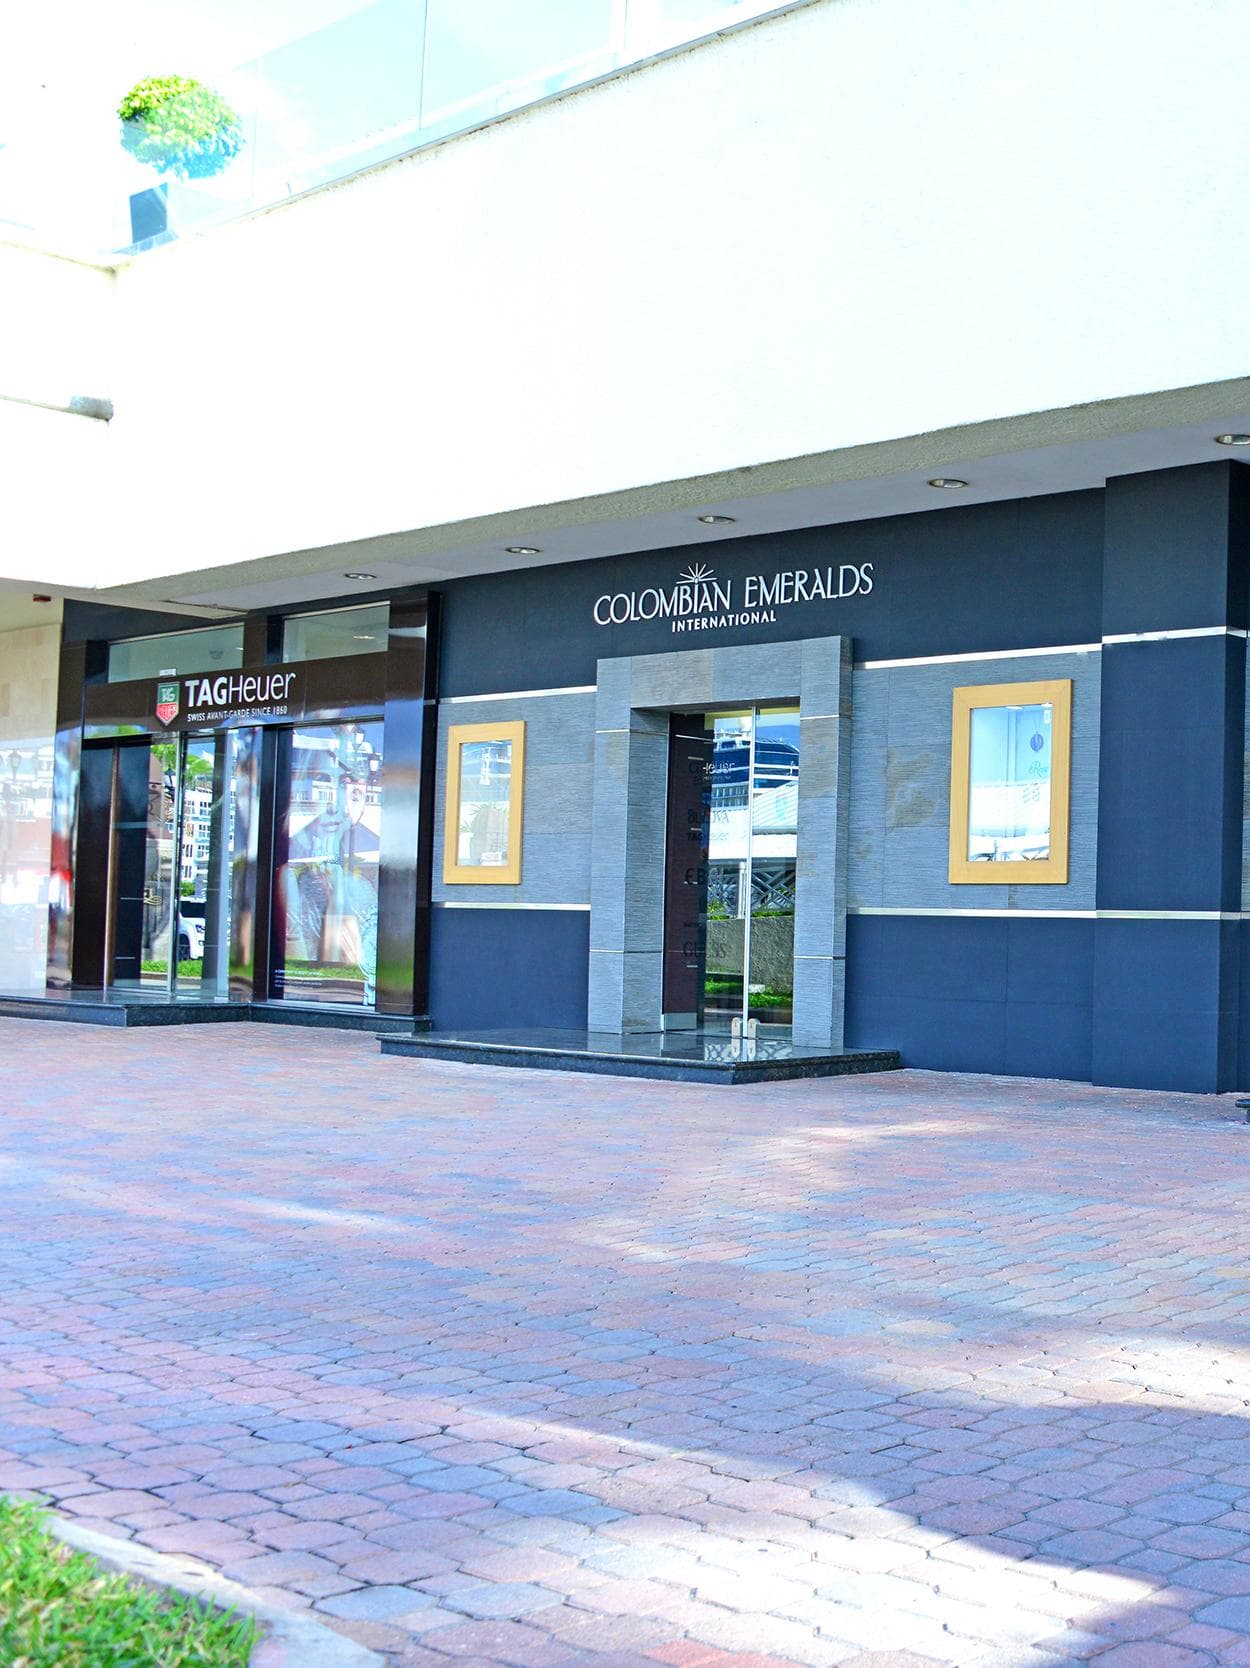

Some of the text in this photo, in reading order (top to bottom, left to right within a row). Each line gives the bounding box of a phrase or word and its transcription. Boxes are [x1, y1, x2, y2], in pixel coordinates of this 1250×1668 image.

[593, 563, 874, 625] COLOMBIAN EMERALDS
[672, 610, 776, 633] INTERNATIONAL
[187, 713, 206, 722] SWISS
[251, 706, 271, 717] SINCE
